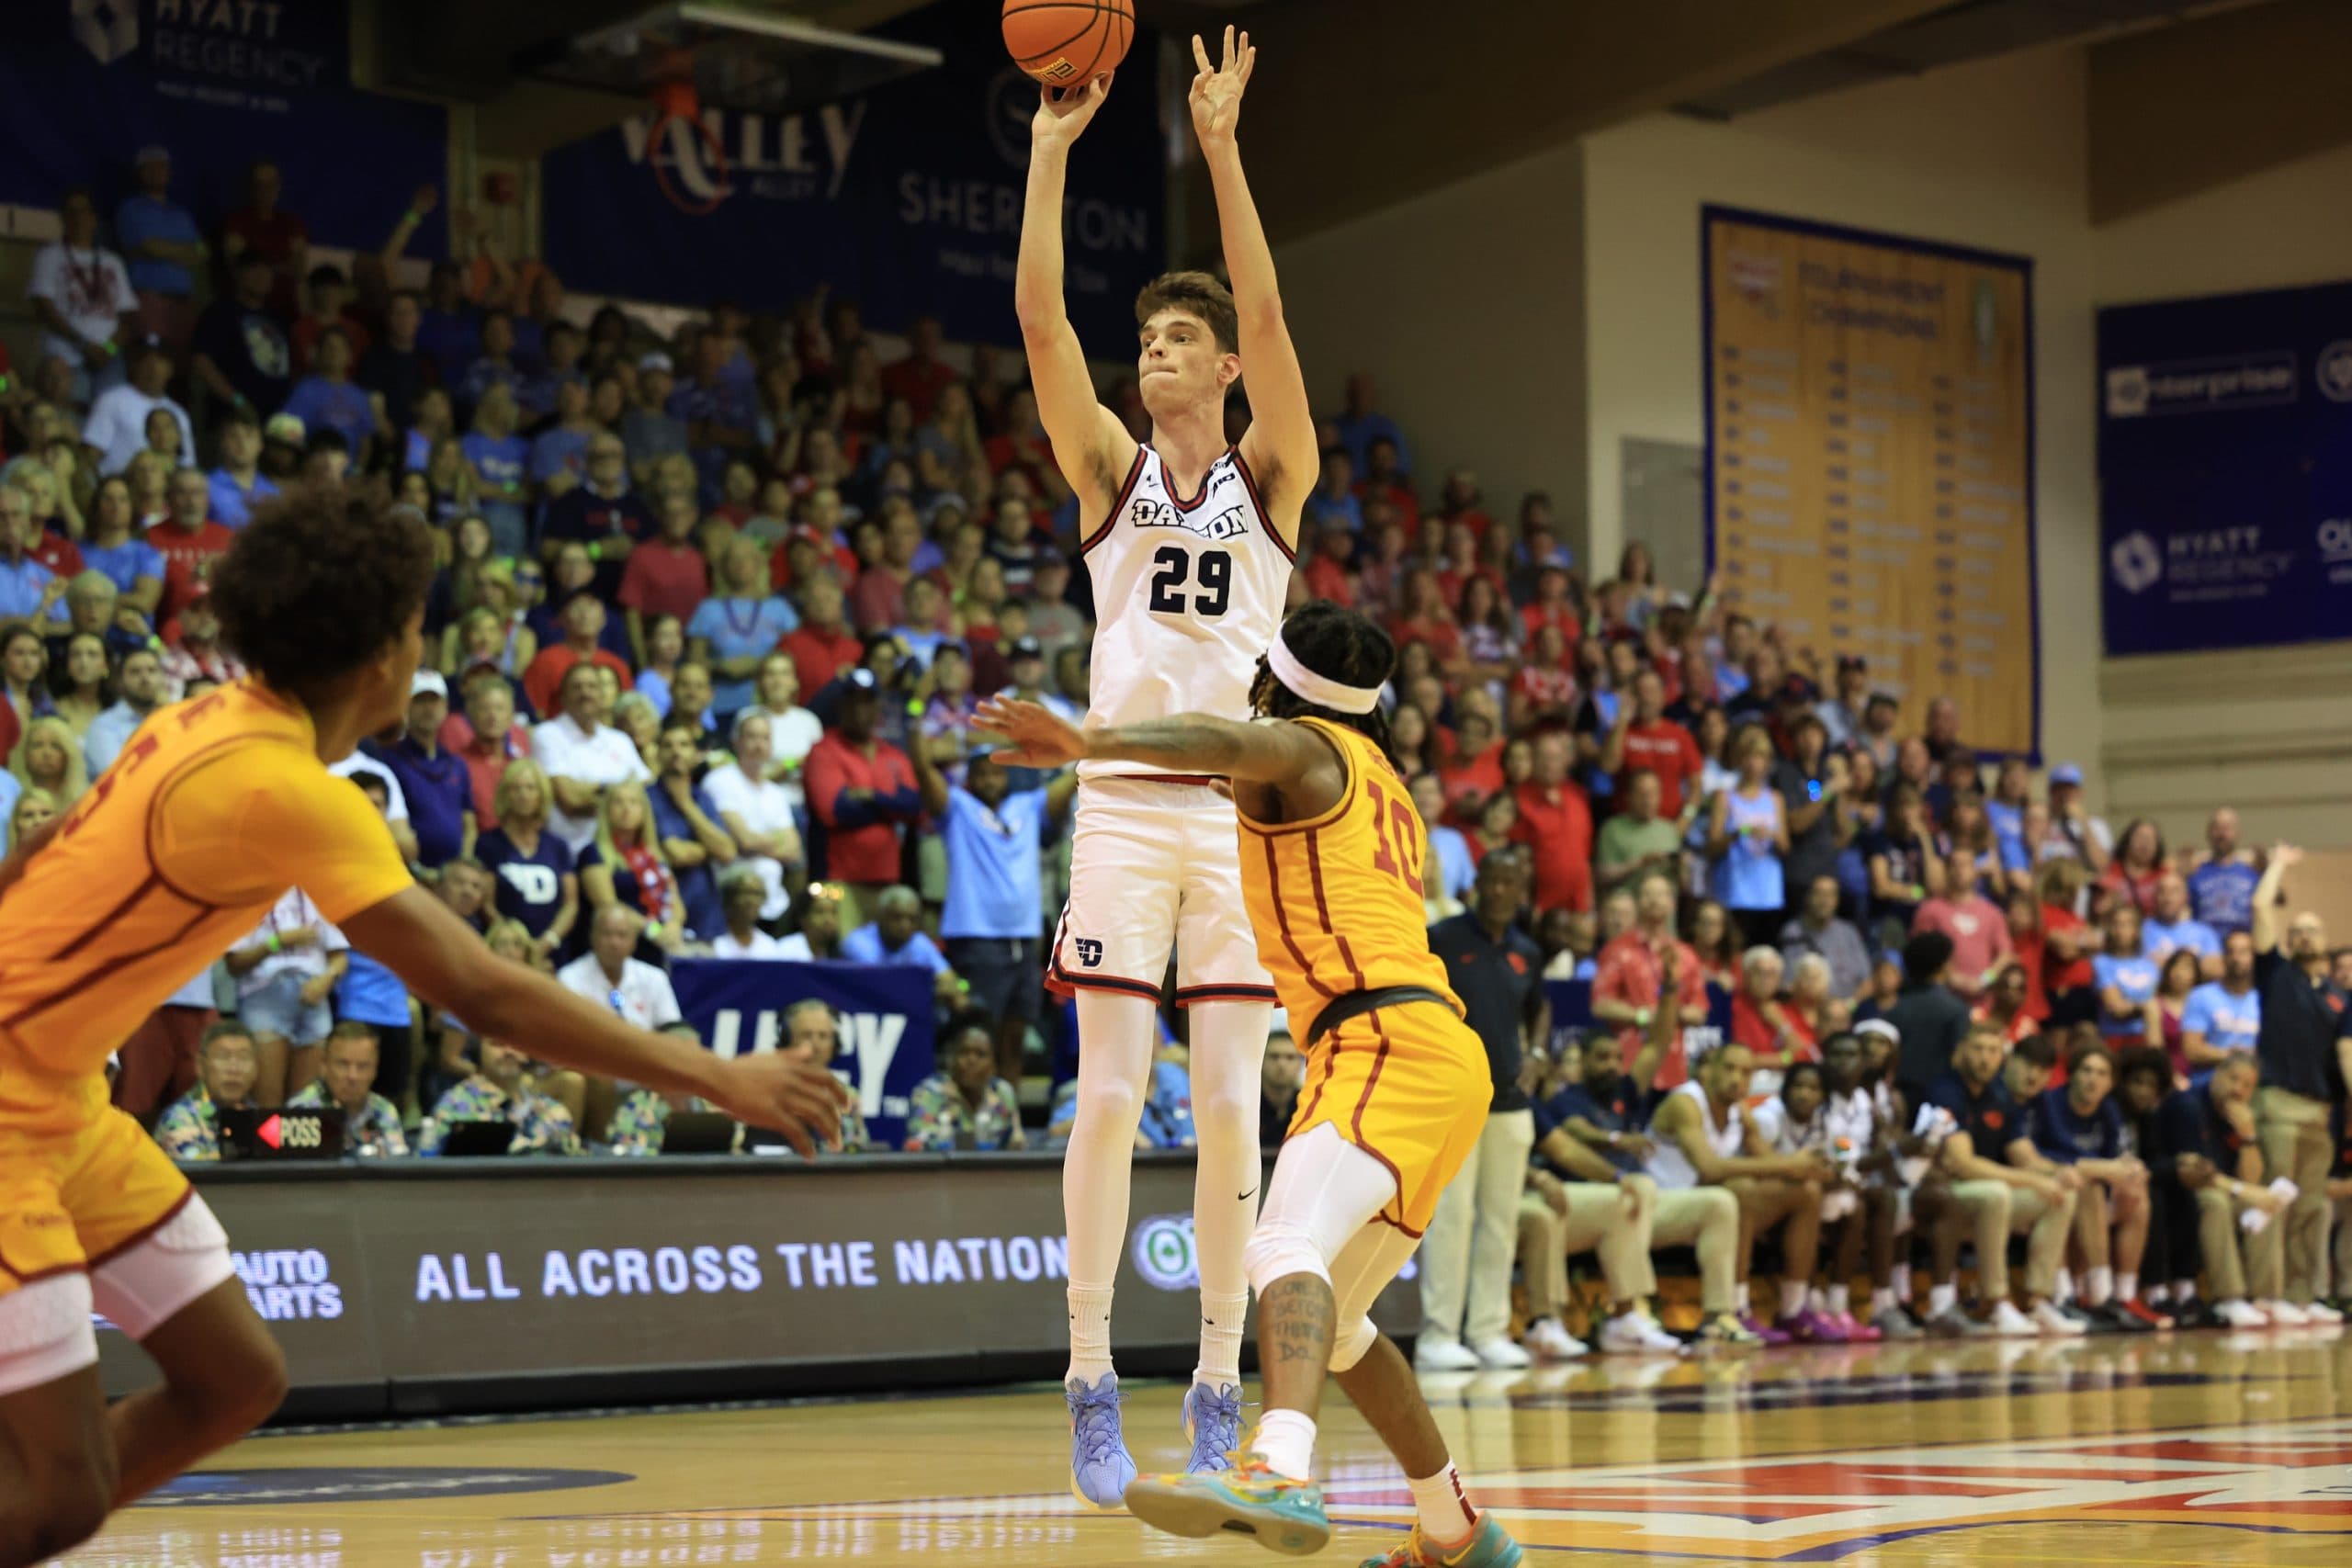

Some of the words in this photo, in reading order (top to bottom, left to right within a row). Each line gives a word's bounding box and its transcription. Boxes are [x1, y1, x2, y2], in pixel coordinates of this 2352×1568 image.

[154, 0, 286, 39] HYATT
[897, 170, 1148, 254] SHERTON
[1132, 498, 1249, 539] DAON
[1149, 546, 1232, 616] 29
[1367, 779, 1425, 900] 10
[279, 1115, 322, 1148] POSS
[416, 1252, 521, 1301] ALL
[542, 1244, 763, 1298] ACROSS
[775, 1241, 878, 1288] THE
[893, 1235, 1069, 1284] NATION
